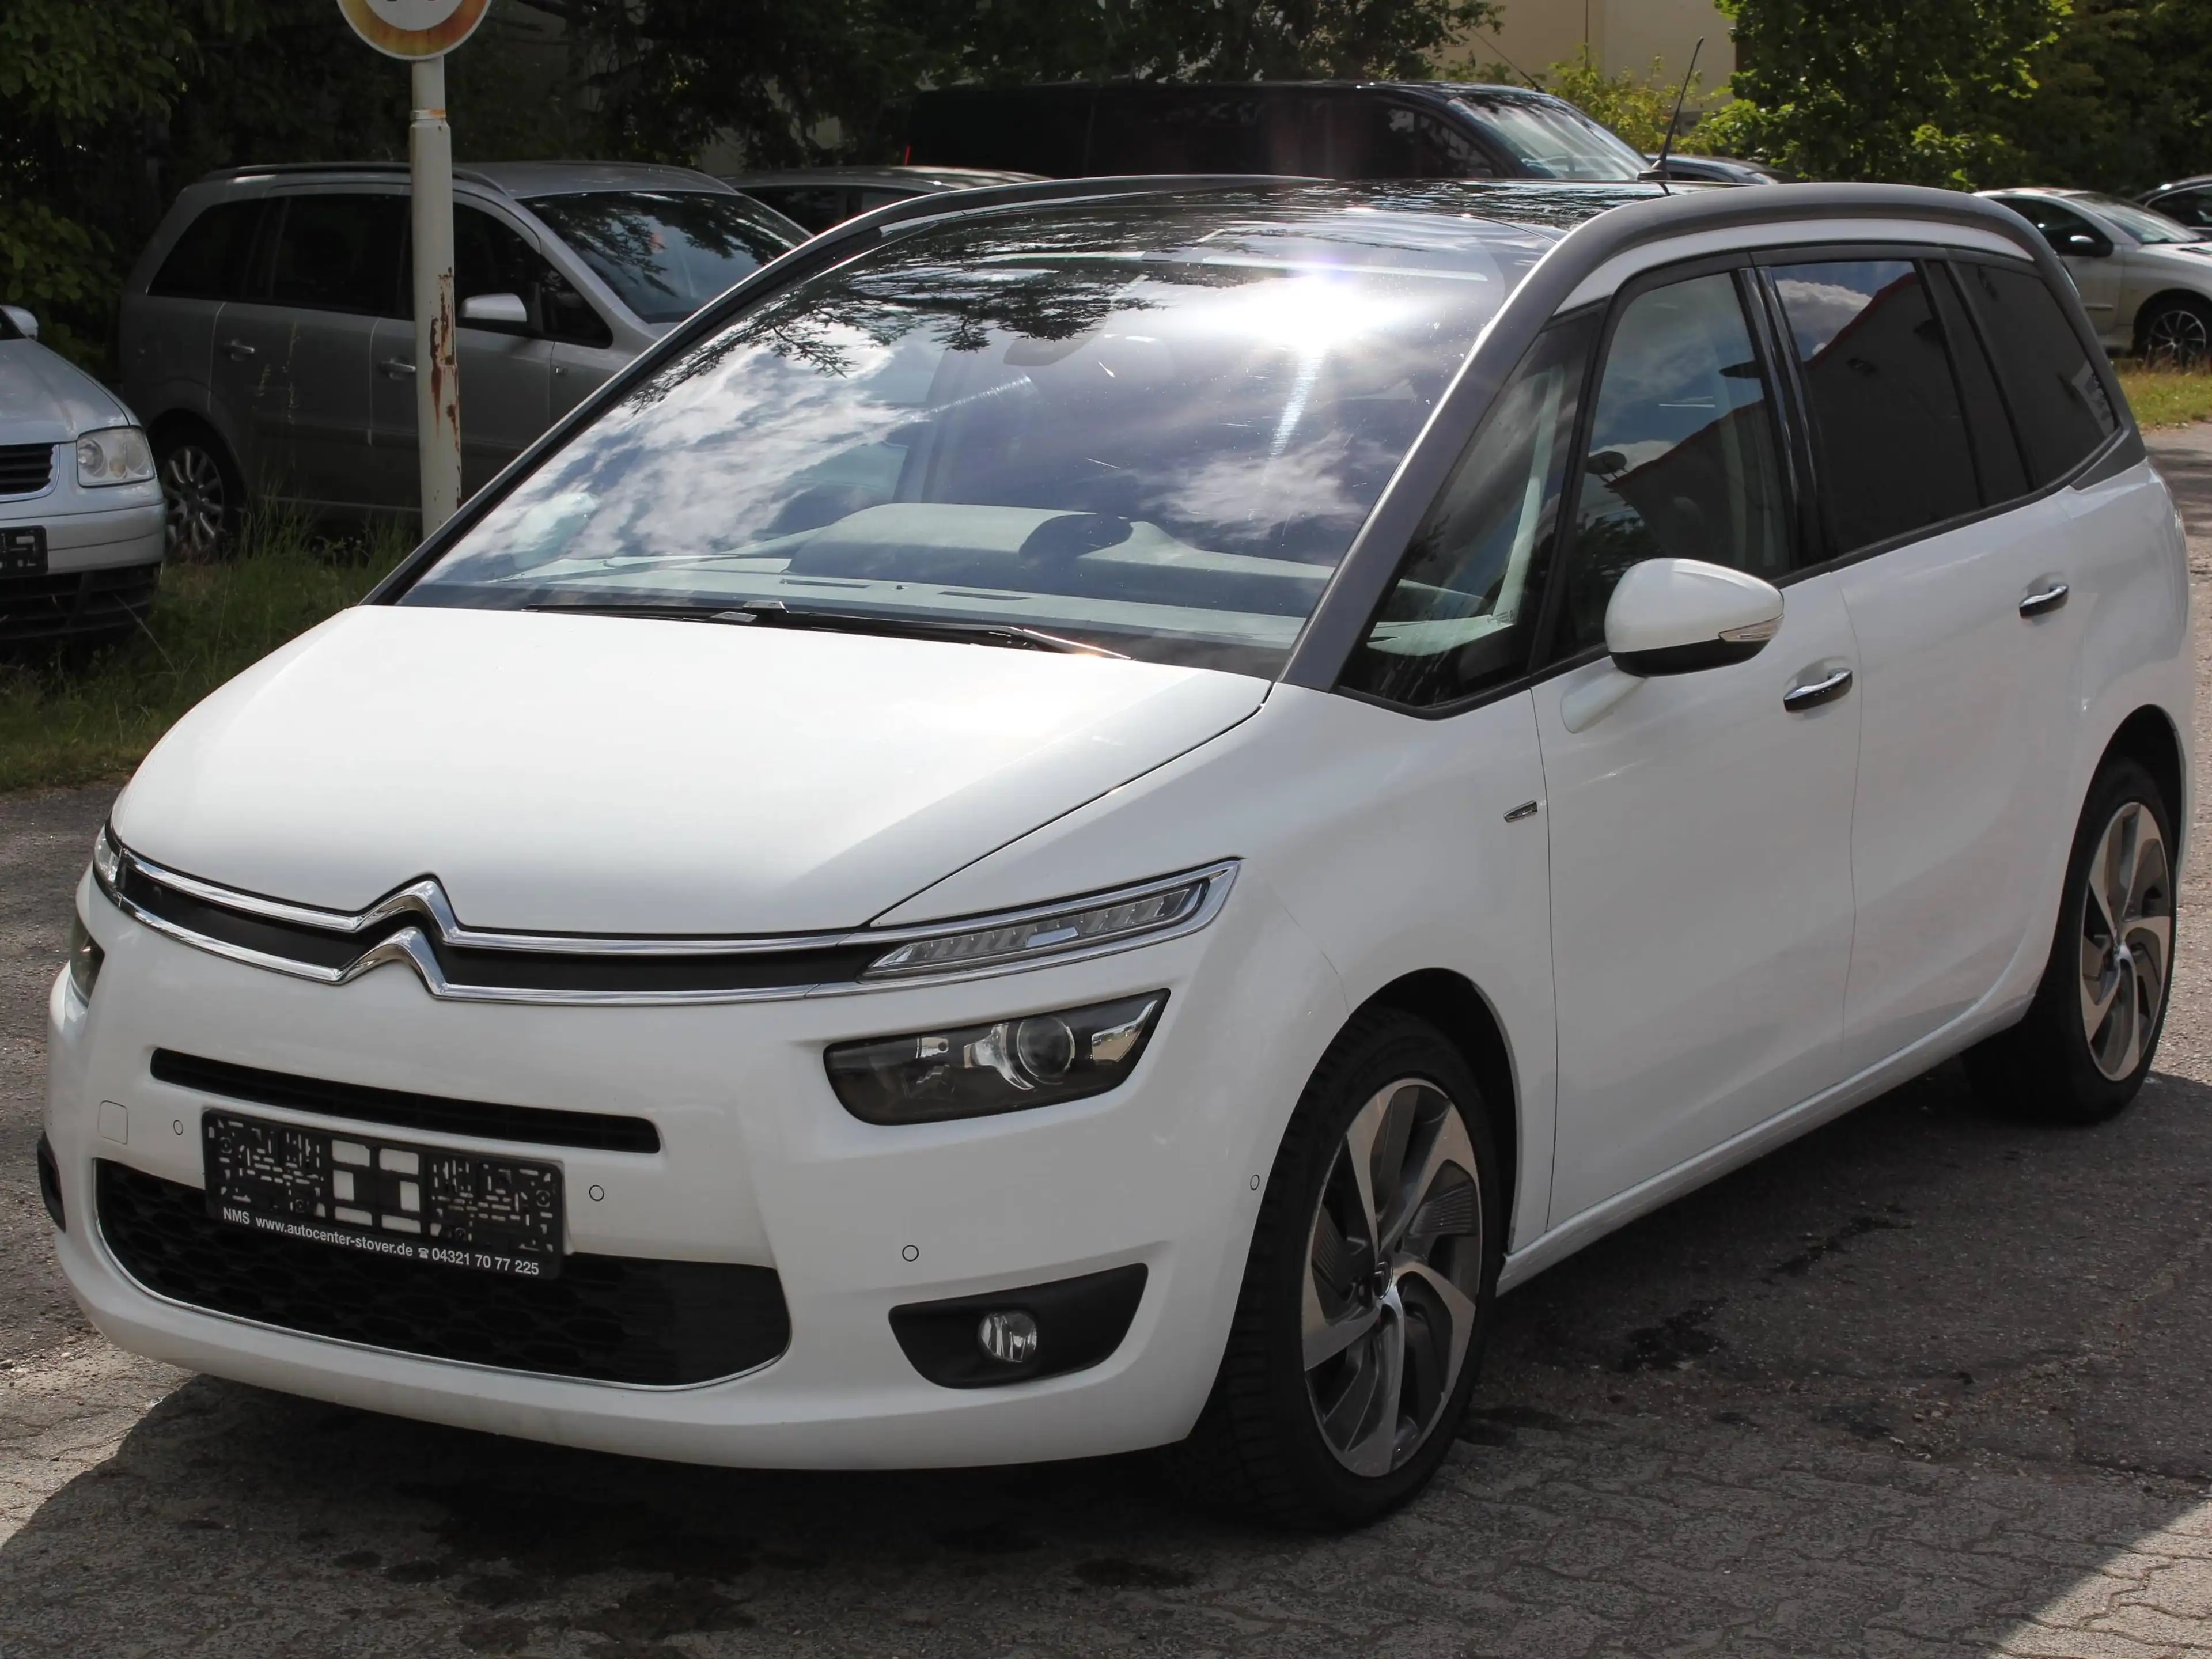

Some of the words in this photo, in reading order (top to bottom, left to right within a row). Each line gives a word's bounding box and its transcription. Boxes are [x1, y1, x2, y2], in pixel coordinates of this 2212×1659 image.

[223, 1207, 251, 1225] NMS
[255, 1217, 414, 1257] www.autocenter-stover.de
[432, 1248, 469, 1266] 04321
[475, 1254, 491, 1268] 70
[494, 1256, 511, 1271] 77
[514, 1260, 539, 1275] 225
